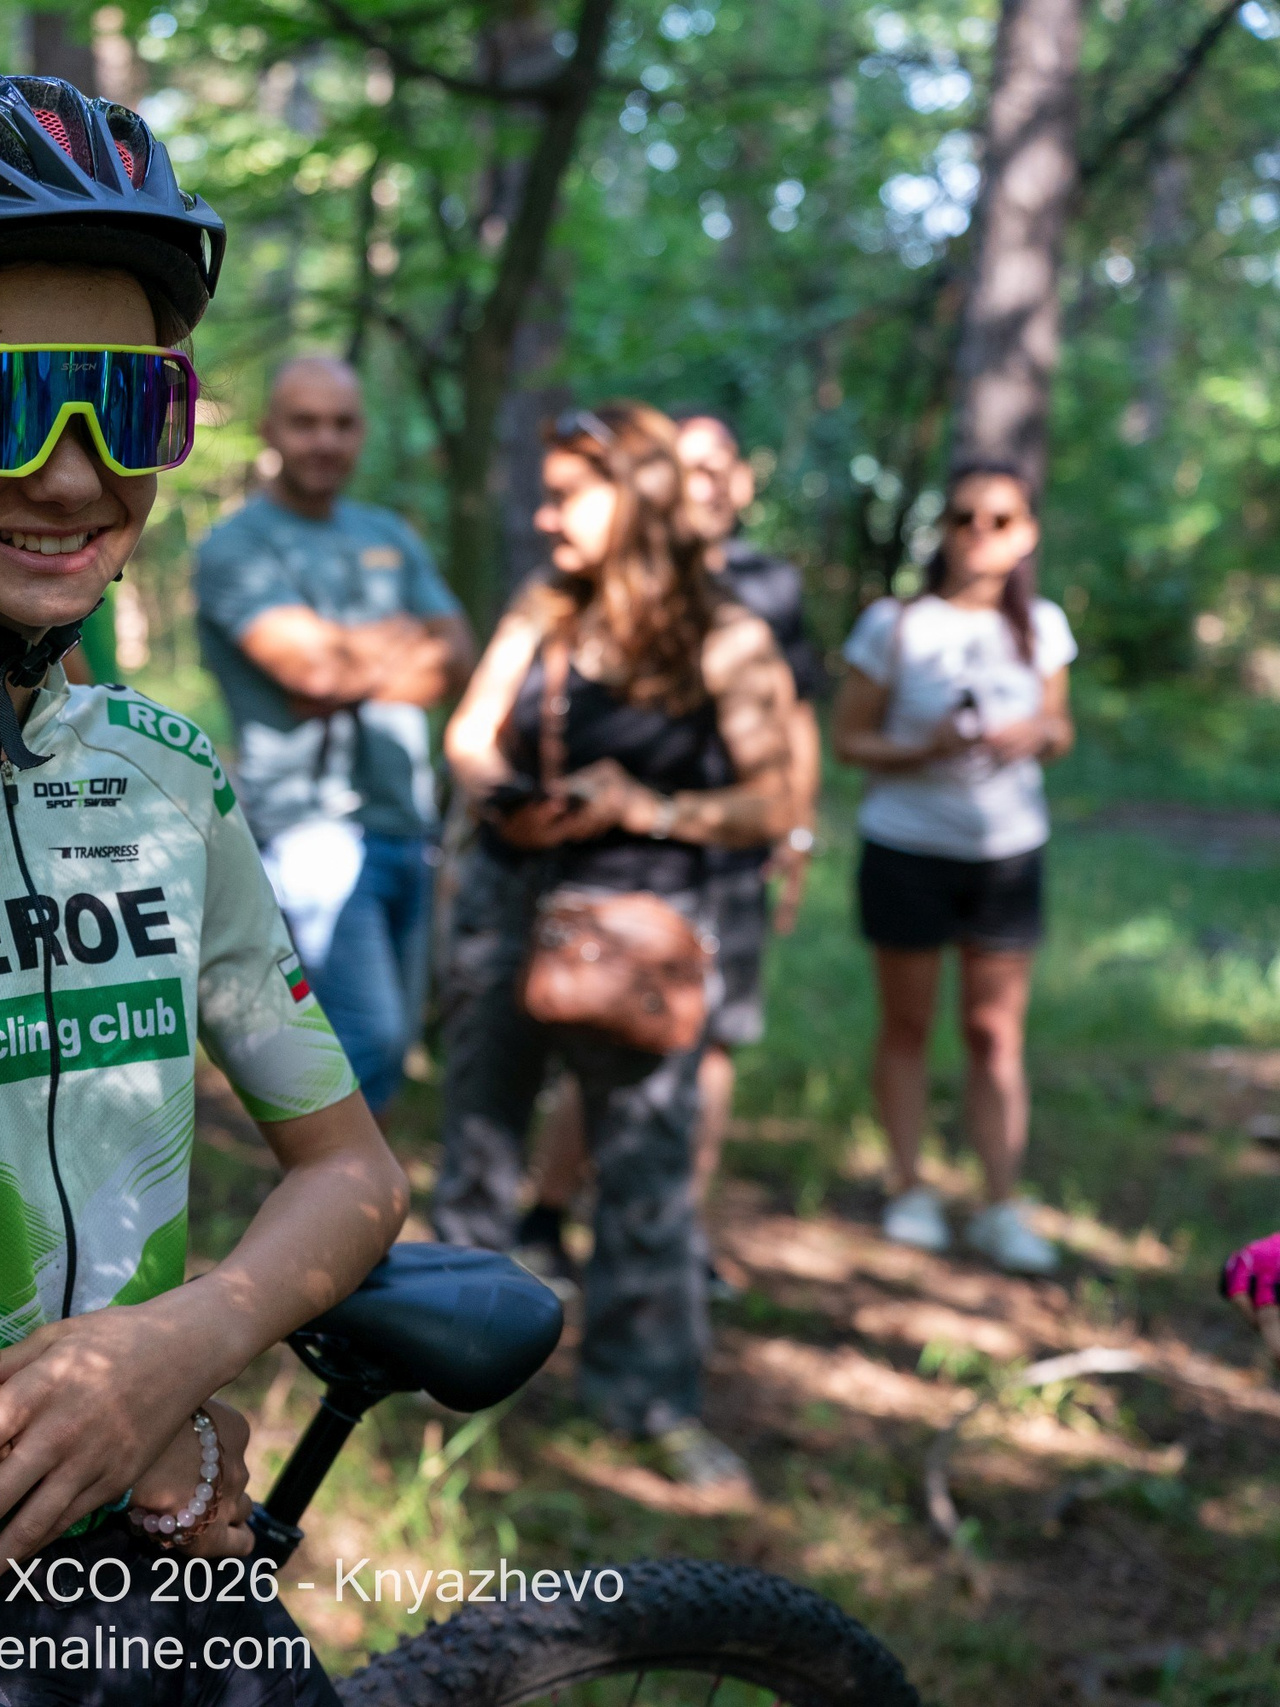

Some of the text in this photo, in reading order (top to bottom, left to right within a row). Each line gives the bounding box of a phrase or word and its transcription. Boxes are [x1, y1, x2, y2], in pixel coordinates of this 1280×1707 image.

[127, 702, 227, 791] ROAD
[74, 844, 139, 859] TRANSPRESS
[89, 996, 177, 1042] club
